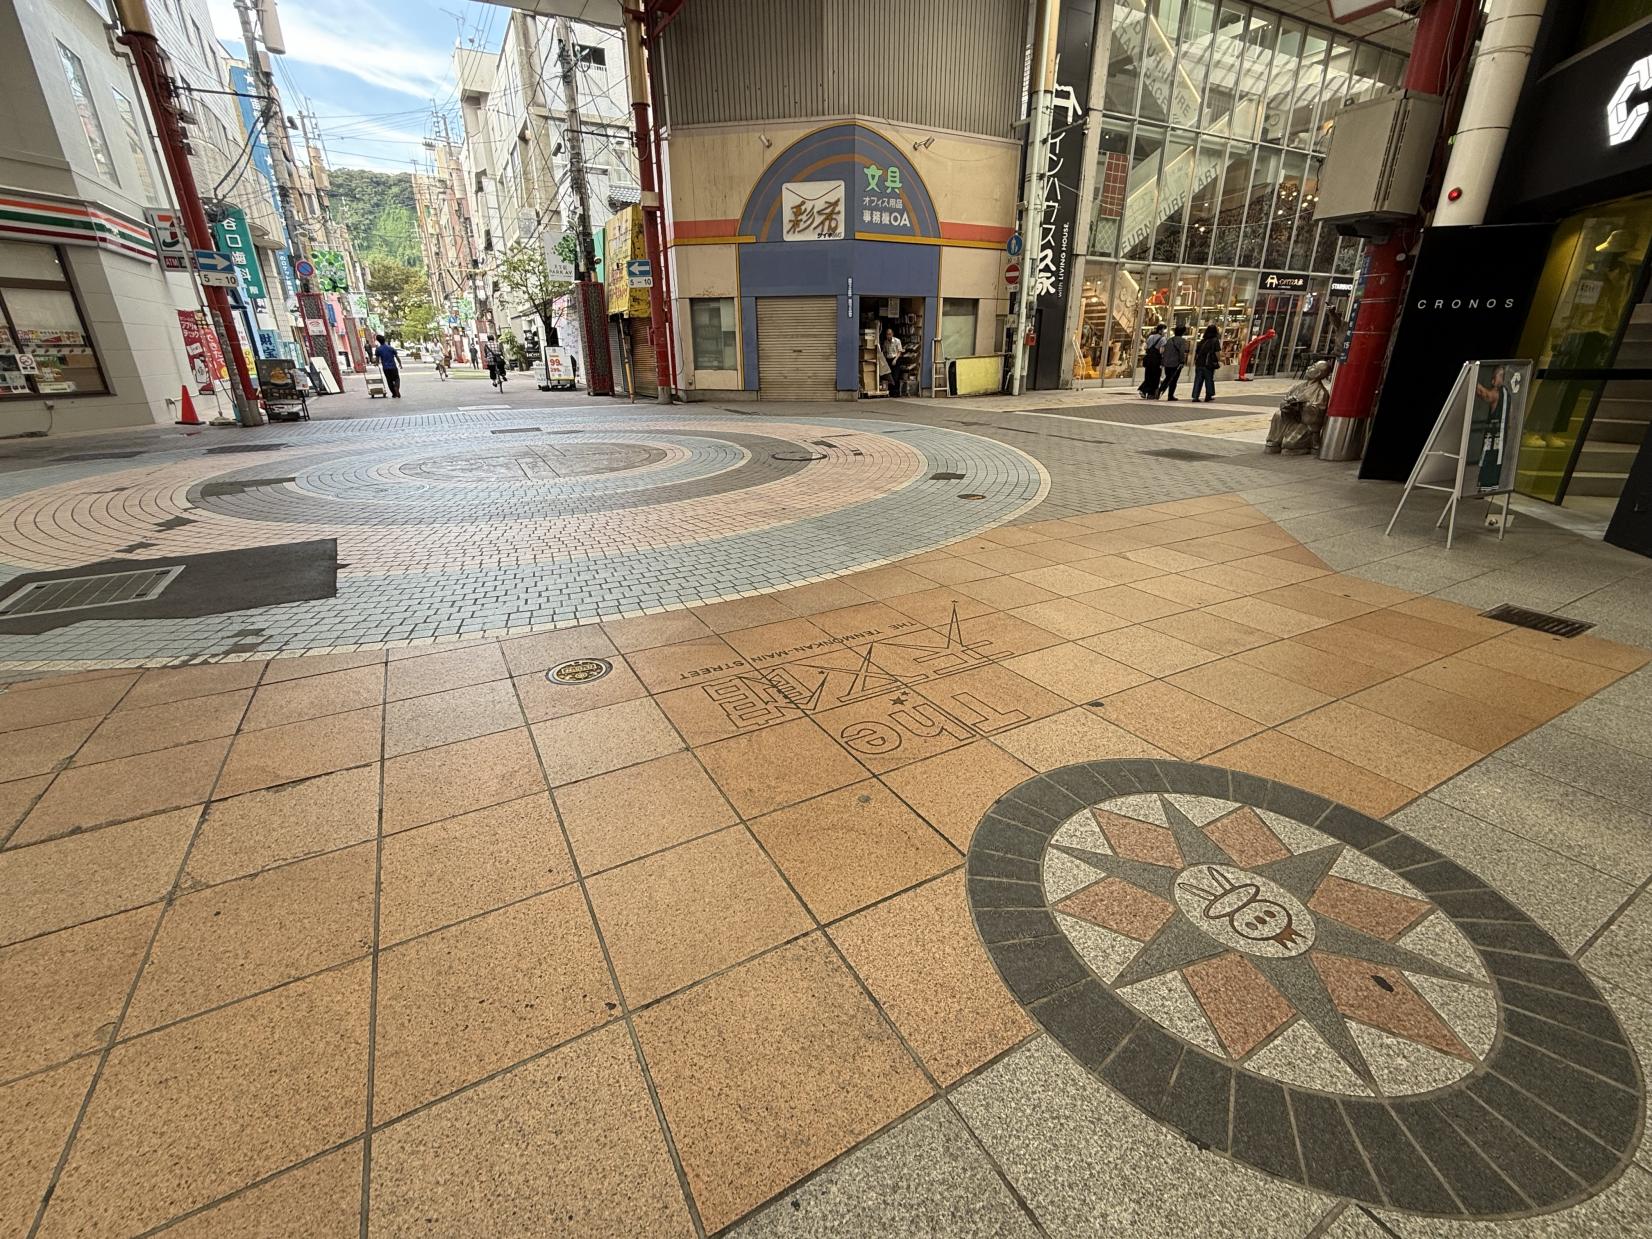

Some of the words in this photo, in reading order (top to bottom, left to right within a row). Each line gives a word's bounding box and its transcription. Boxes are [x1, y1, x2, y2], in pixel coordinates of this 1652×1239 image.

[863, 165, 902, 193] 文具
[863, 196, 902, 209] オフィス用品
[863, 210, 910, 227] 事務機OA
[1058, 252, 1066, 280] LIVING
[1417, 298, 1515, 309] CRONOS
[890, 620, 917, 631] THE
[750, 627, 882, 663] TENMONKAN-MAIN
[677, 659, 745, 681] STREET
[703, 600, 1014, 730] 天文館
[841, 692, 1031, 755] The
